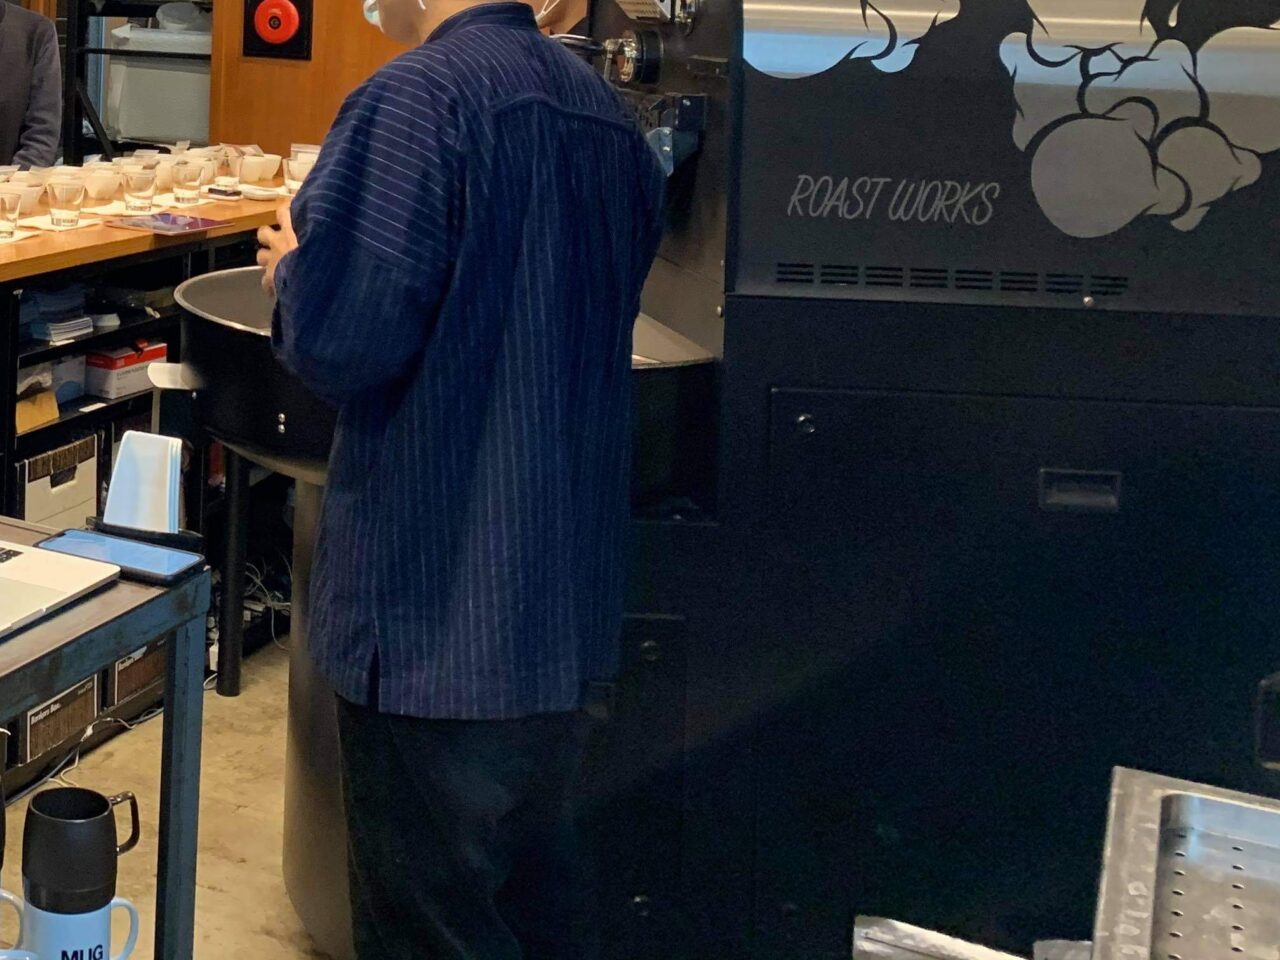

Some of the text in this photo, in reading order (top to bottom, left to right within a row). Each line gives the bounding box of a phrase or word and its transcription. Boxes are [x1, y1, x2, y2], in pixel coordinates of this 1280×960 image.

[787, 174, 1001, 226] ROAST WORKS
[61, 943, 104, 960] MUG
